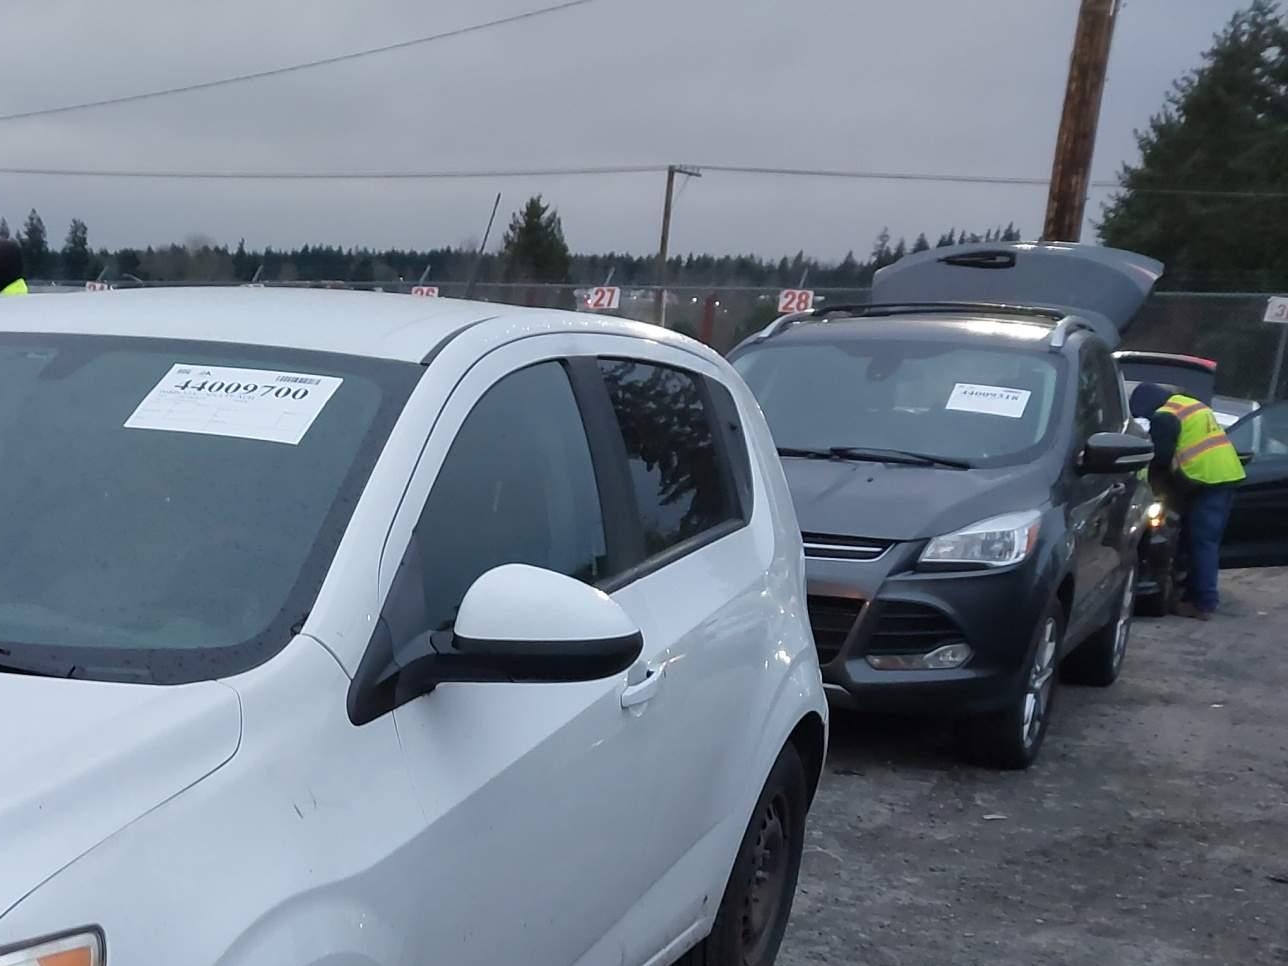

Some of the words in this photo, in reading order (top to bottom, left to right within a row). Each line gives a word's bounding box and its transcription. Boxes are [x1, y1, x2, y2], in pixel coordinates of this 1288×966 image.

[592, 287, 616, 307] 27
[782, 290, 810, 311] 28
[174, 379, 310, 401] 44009700
